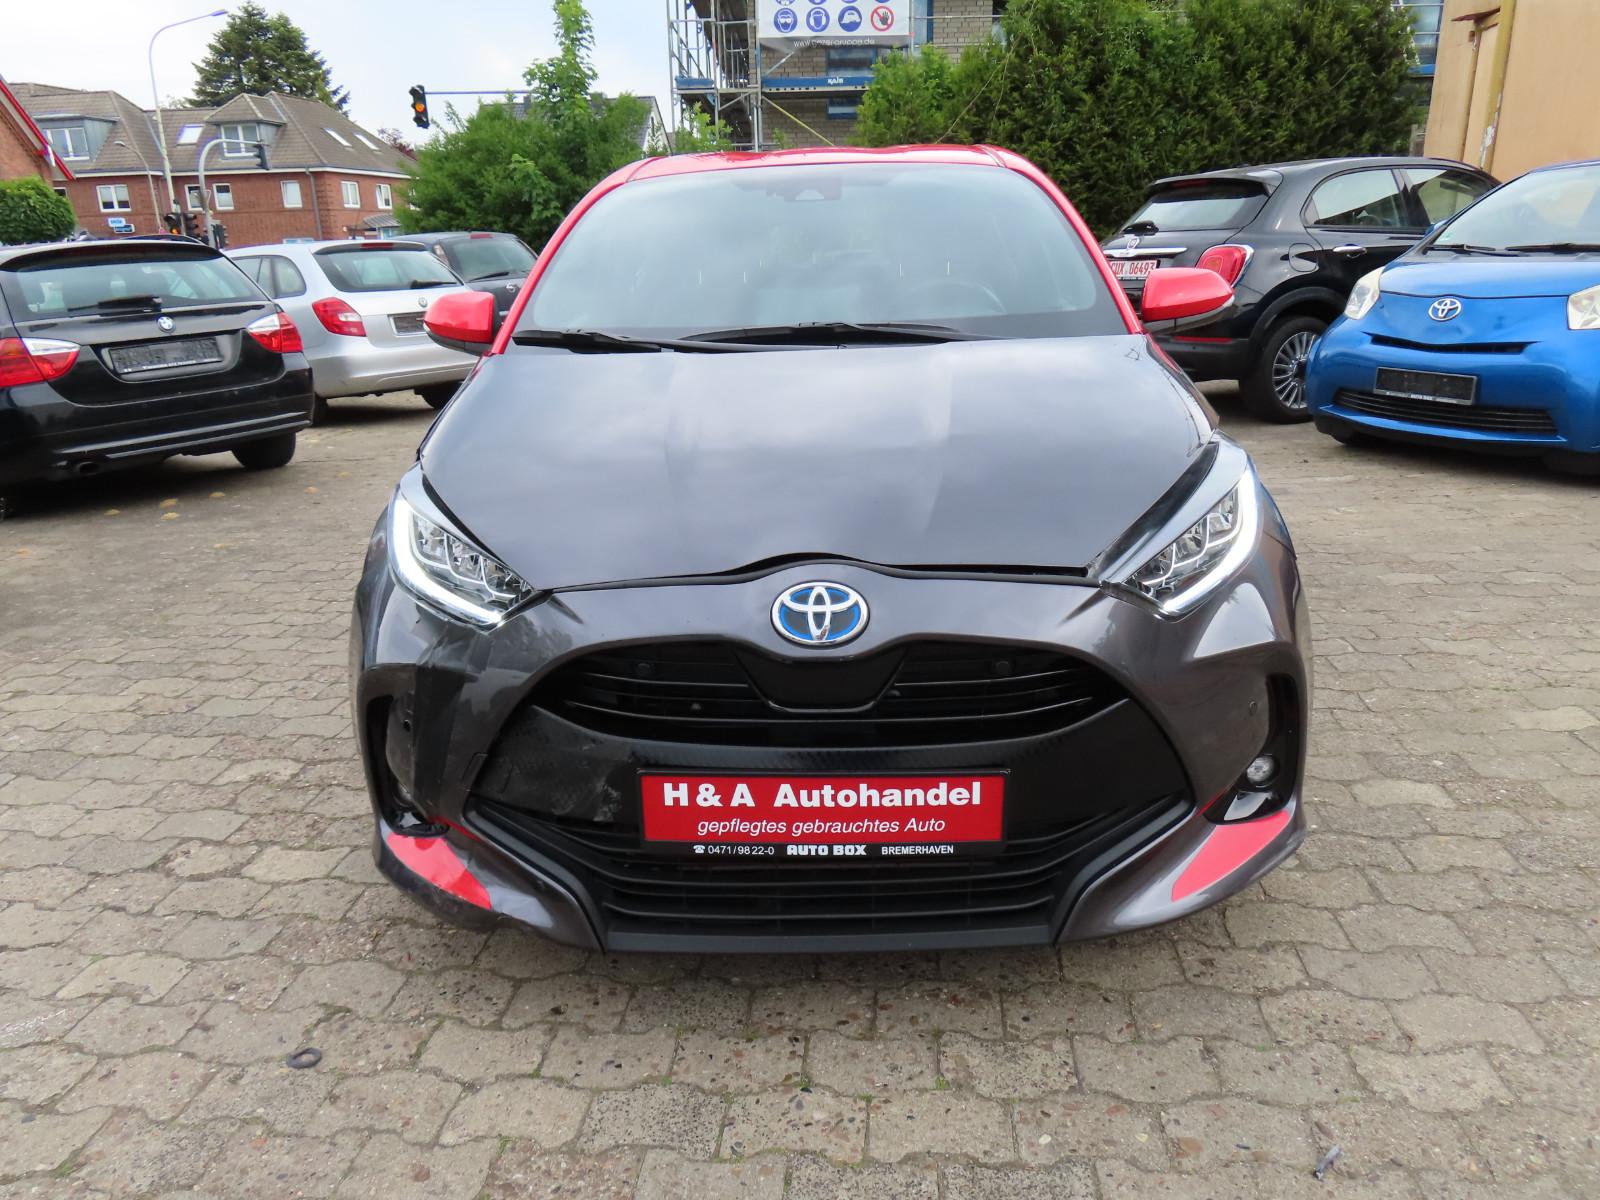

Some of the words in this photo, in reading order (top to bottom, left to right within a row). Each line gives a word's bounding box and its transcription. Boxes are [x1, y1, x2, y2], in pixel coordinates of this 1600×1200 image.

[1129, 261, 1155, 275] 06493
[663, 782, 689, 807] H
[696, 783, 723, 807] &
[730, 783, 756, 807] A
[773, 781, 981, 808] Autohandel
[697, 818, 787, 836] gepflegtes
[791, 818, 900, 837] gebrauchtes
[904, 817, 946, 832] Auto
[786, 844, 829, 856] AUTO
[833, 844, 867, 856] BOX
[881, 844, 954, 856] BREMERHAVEN
